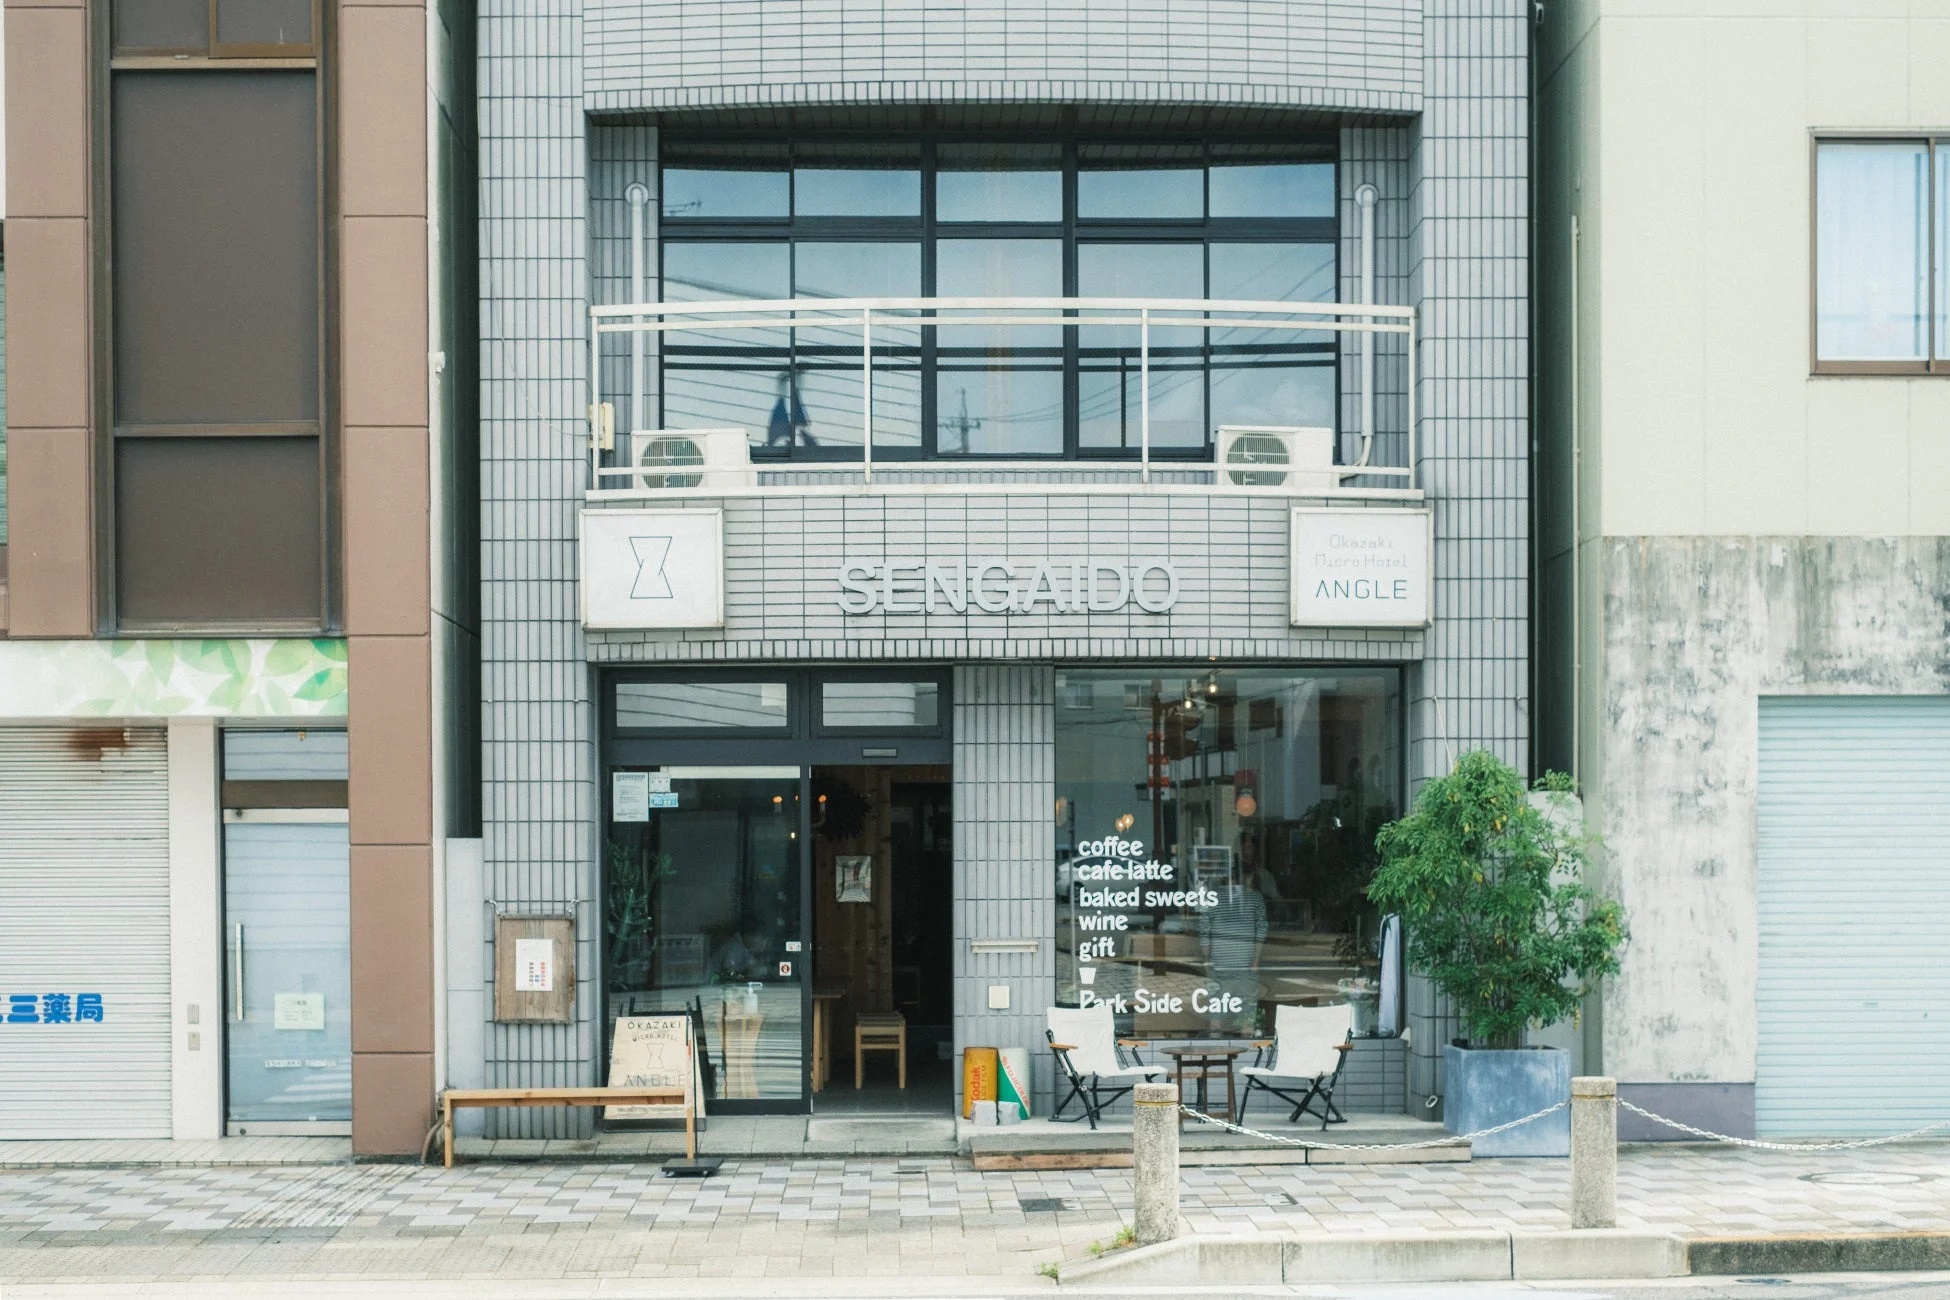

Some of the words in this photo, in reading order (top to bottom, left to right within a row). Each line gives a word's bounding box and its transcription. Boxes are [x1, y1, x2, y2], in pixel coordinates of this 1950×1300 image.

[1329, 533, 1393, 549] Okazaki
[1315, 552, 1360, 568] Micro
[1364, 552, 1408, 568] Hotel
[838, 559, 1180, 613] SENGAIDO
[1315, 578, 1408, 599] ANGLE
[1078, 835, 1144, 856] coffee
[1078, 859, 1124, 880] cafe
[1128, 859, 1174, 880] latte
[1079, 887, 1140, 907] baked
[1145, 887, 1219, 907] sweets
[1078, 910, 1129, 931] wine
[1079, 937, 1116, 962] gift
[0, 993, 103, 1023] 三薬局
[1134, 988, 1183, 1013] Side
[1191, 988, 1243, 1013] Cafe
[627, 1021, 681, 1030] OKAZAKI
[624, 1073, 685, 1087] ANGLE
